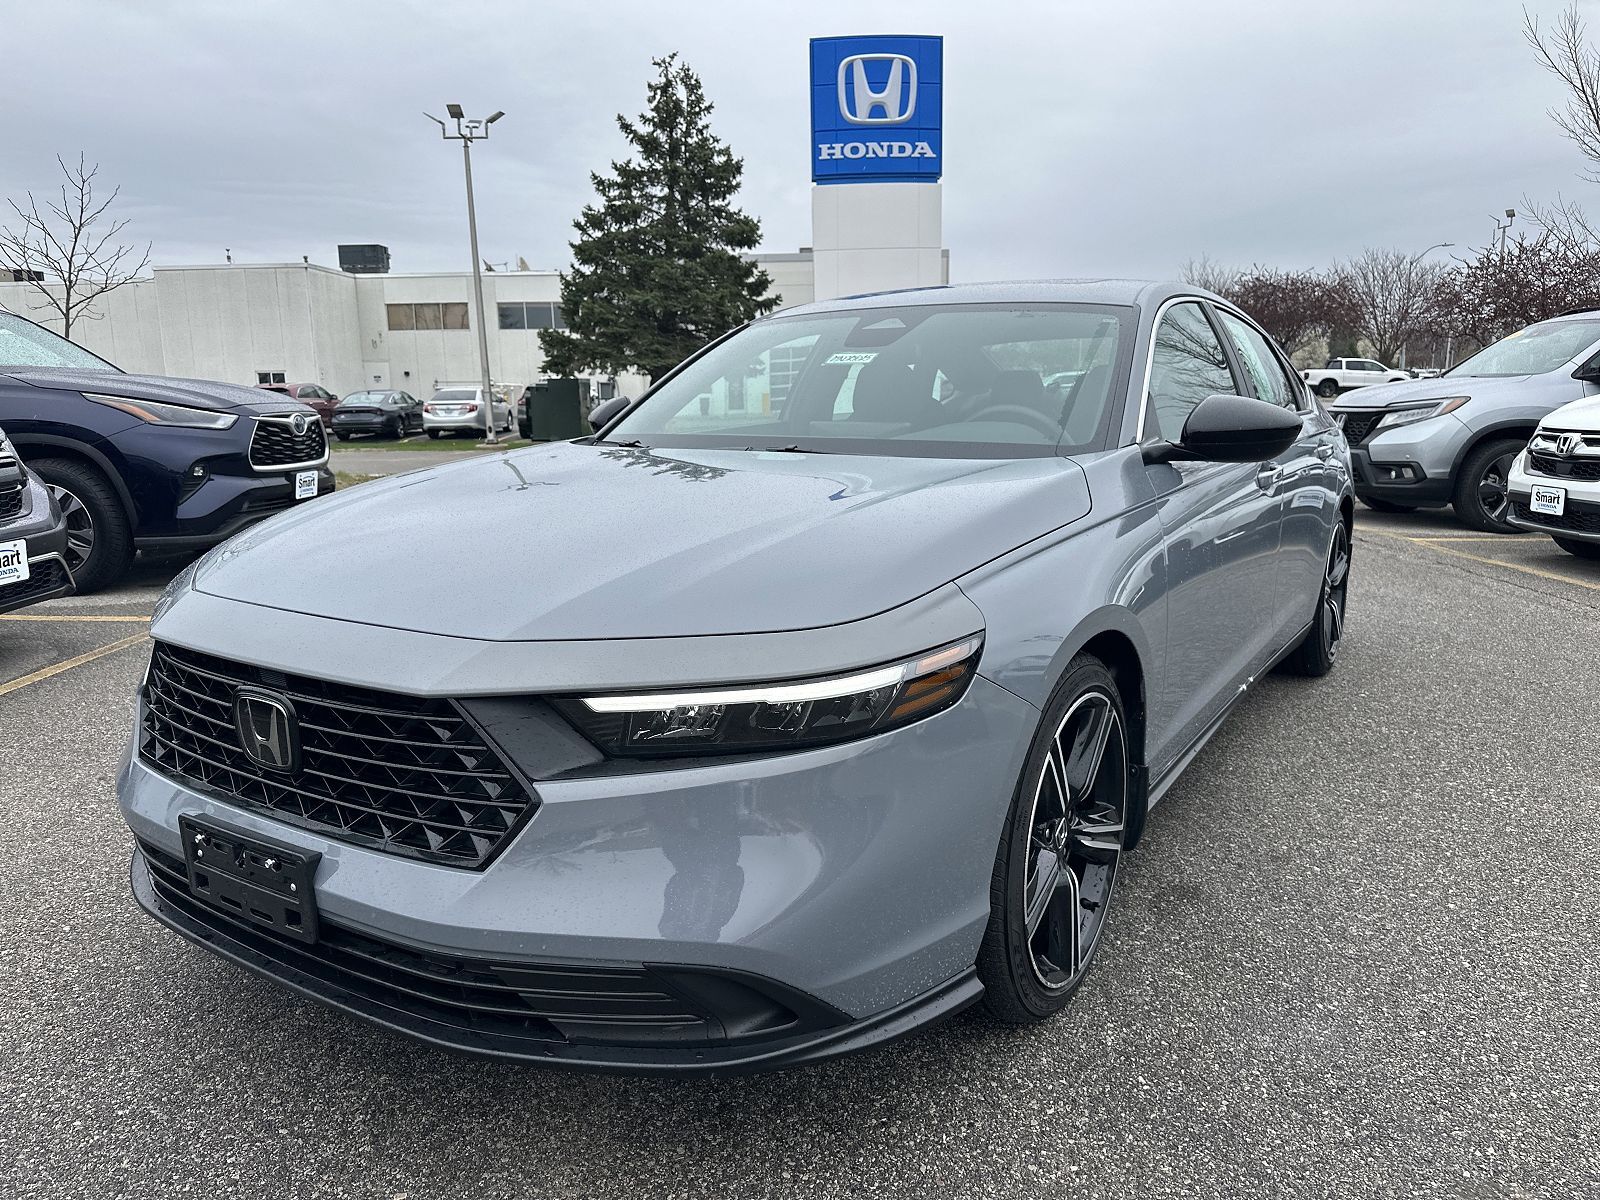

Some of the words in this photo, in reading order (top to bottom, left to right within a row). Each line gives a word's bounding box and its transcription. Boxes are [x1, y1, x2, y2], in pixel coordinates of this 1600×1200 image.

[818, 142, 936, 160] HONDA
[298, 477, 315, 488] Smart
[1535, 491, 1560, 504] Smart
[0, 549, 21, 568] art
